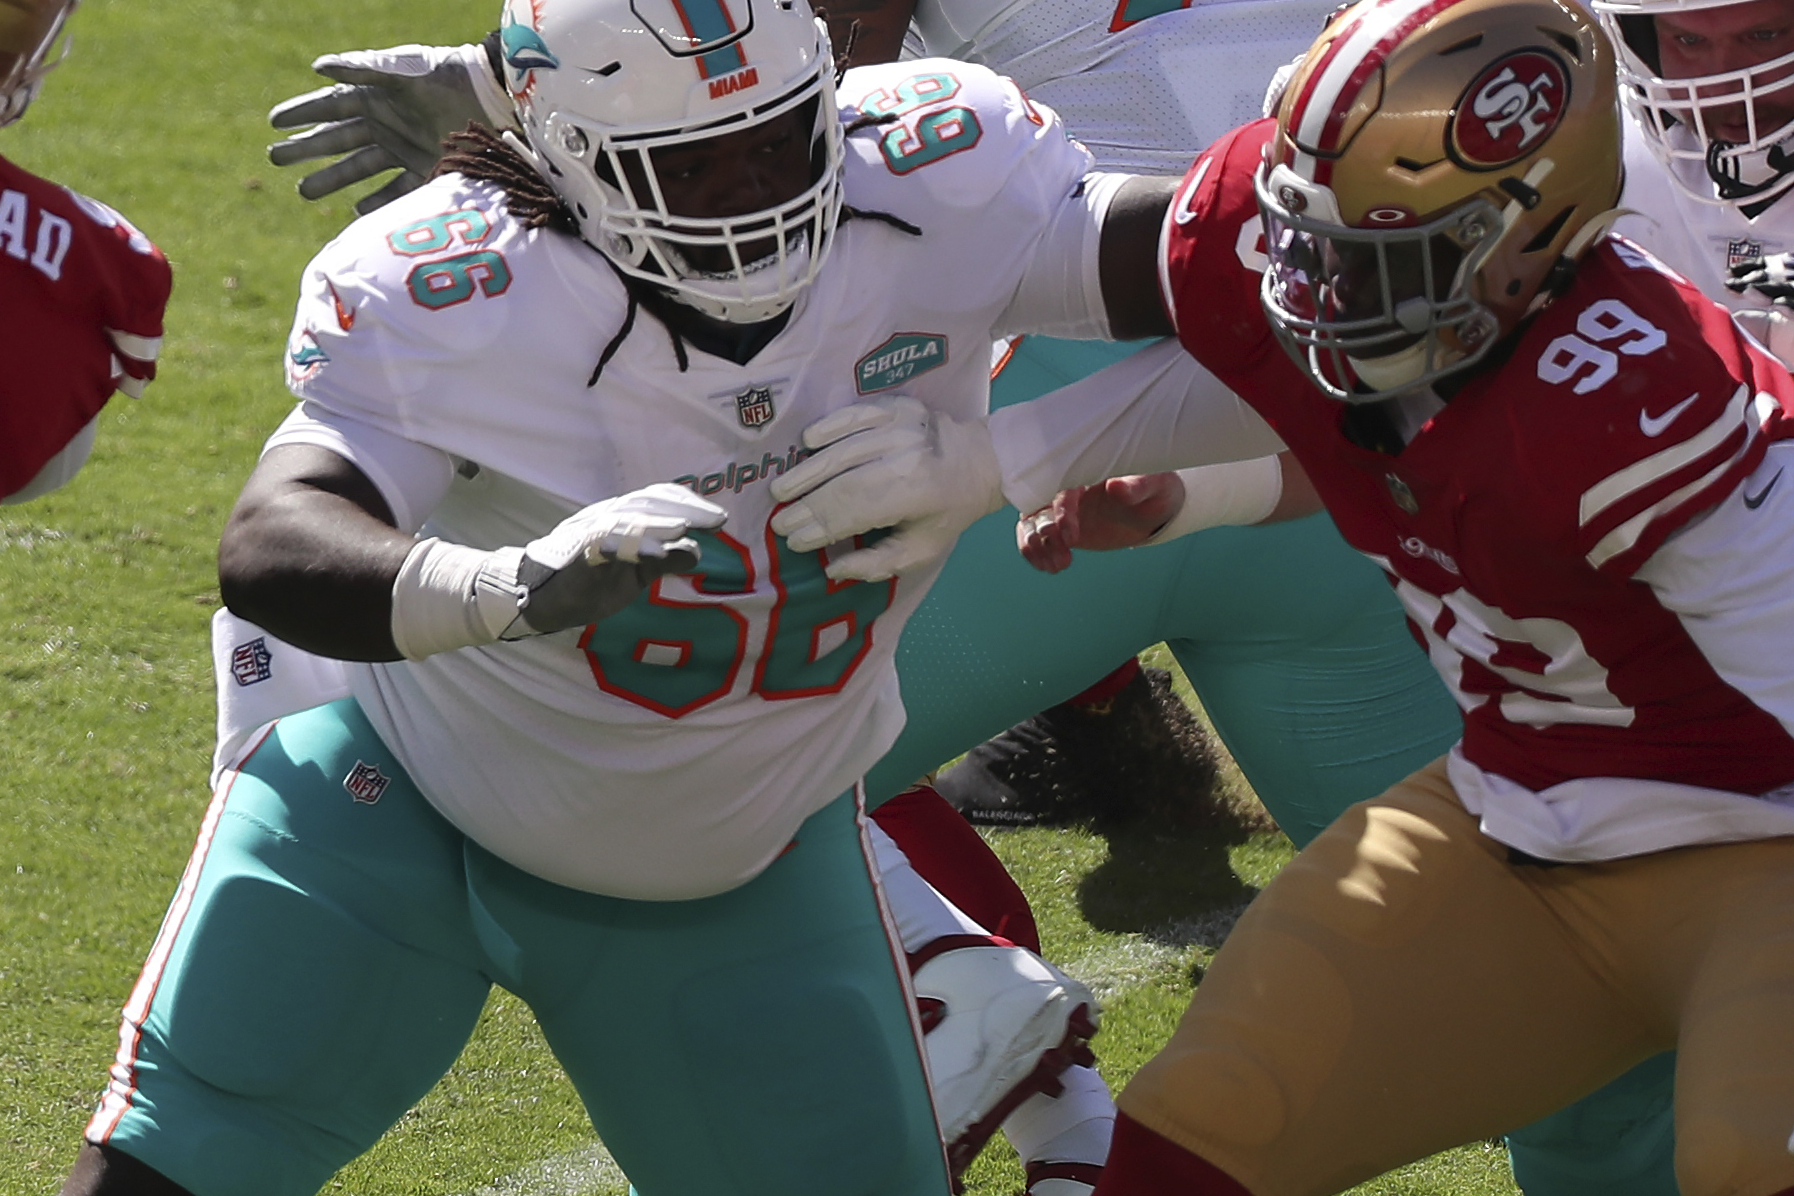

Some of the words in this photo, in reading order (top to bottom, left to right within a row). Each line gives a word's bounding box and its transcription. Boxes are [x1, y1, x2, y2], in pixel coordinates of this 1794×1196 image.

[708, 67, 759, 100] MIAMI
[857, 72, 984, 176] 66
[386, 206, 514, 312] 66
[862, 340, 939, 379] SHULA
[1537, 298, 1668, 396] 99
[884, 362, 915, 385] 347
[742, 404, 771, 425] NFL
[674, 444, 818, 497] Dolphi
[577, 501, 900, 720] 66
[234, 646, 257, 684] NFL
[349, 776, 377, 800] NFL
